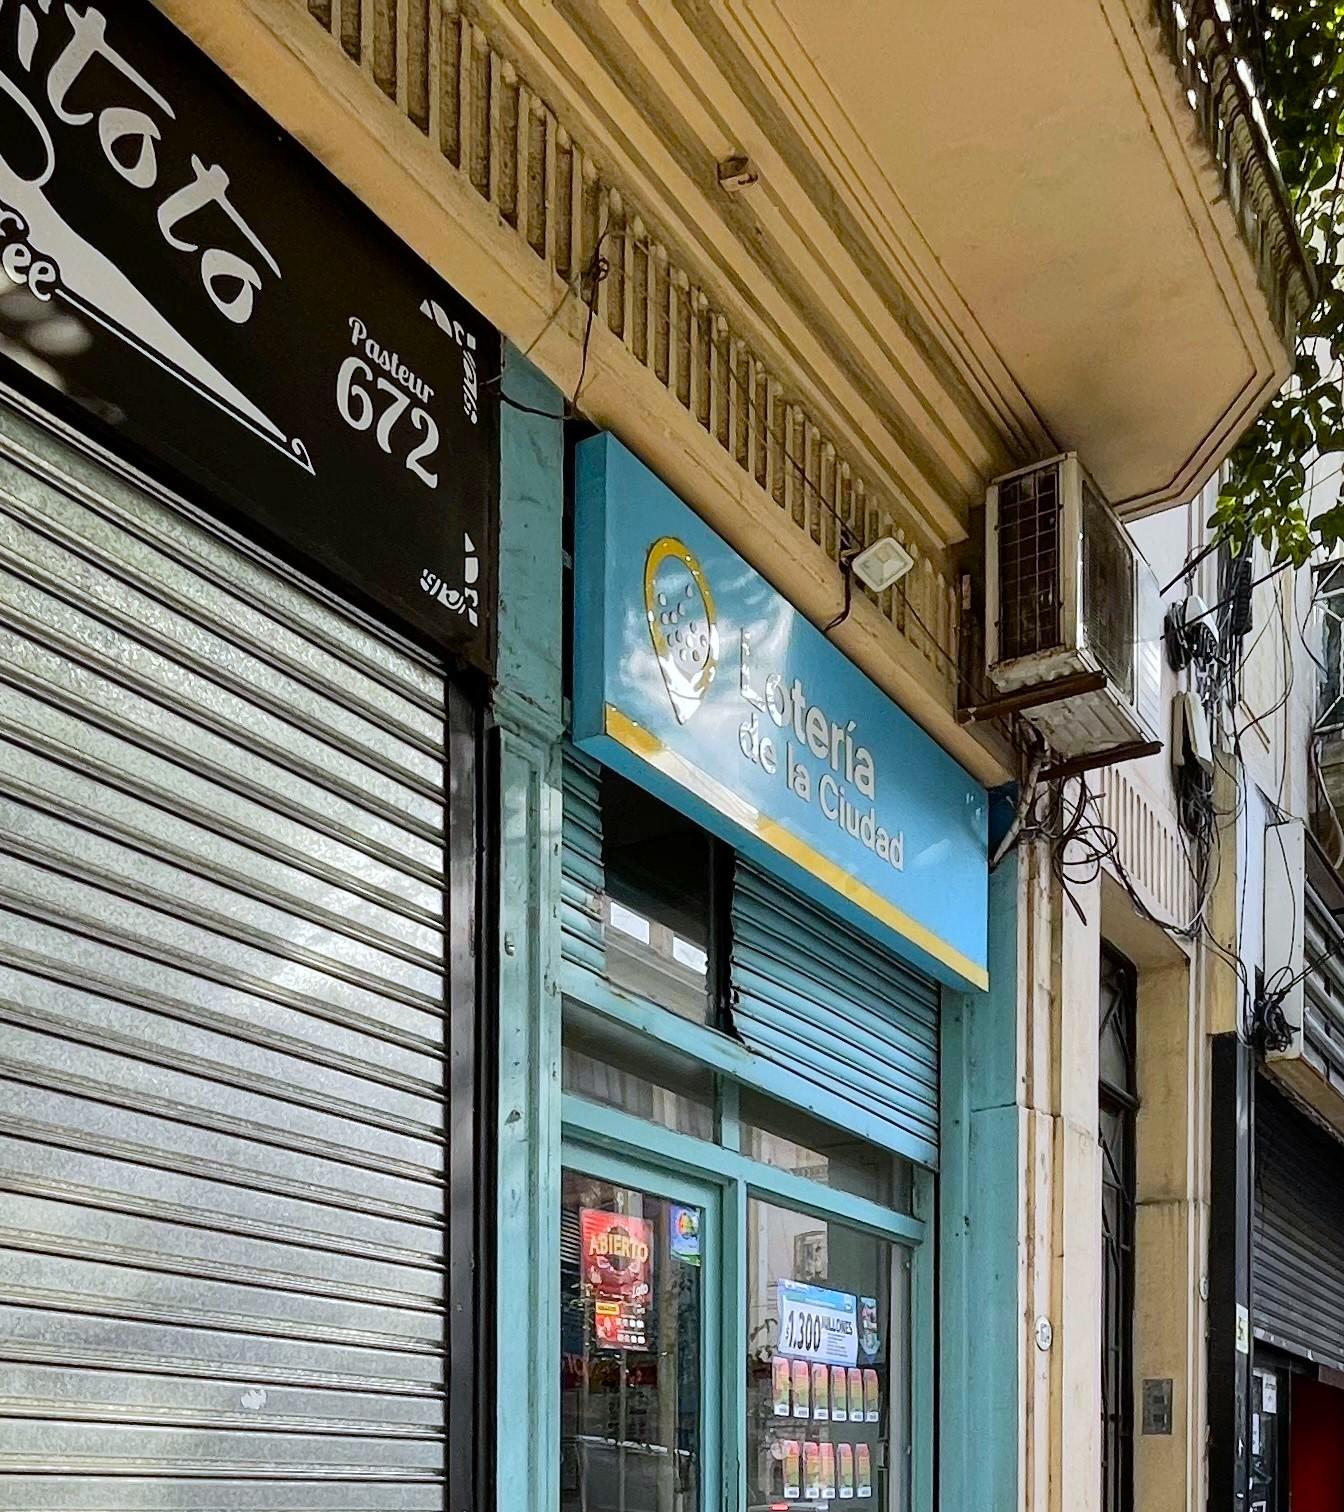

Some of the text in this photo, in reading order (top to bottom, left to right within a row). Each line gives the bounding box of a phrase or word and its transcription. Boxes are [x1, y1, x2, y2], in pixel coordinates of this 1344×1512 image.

[336, 356, 440, 489] 672
[349, 316, 434, 404] Pasteur
[740, 627, 876, 802] Lotería
[738, 712, 905, 873] de la Ciudad
[588, 1232, 649, 1264] ABIERTO
